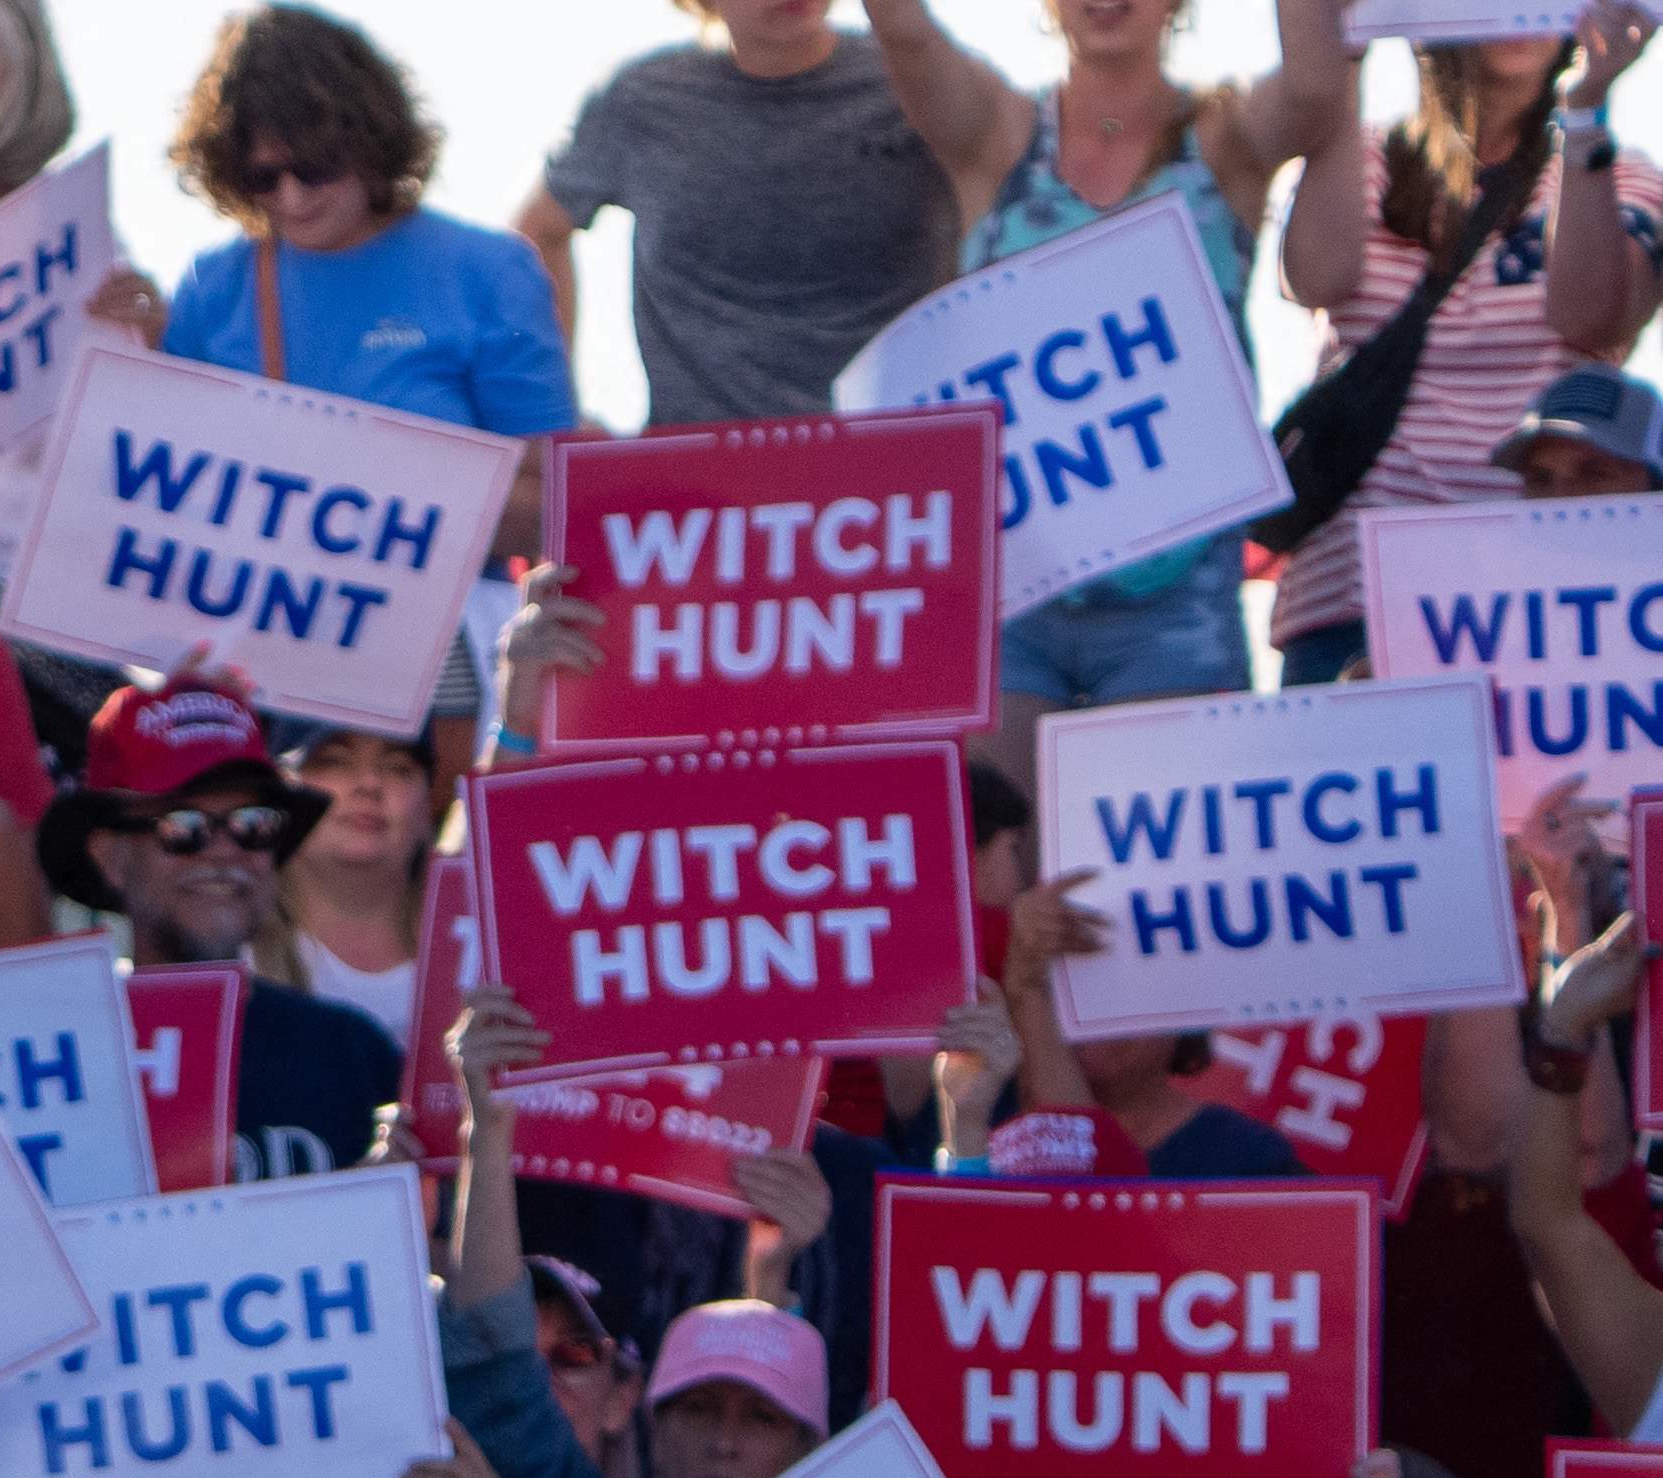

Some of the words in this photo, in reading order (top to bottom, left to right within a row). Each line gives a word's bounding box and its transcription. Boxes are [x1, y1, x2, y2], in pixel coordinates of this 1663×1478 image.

[913, 295, 1181, 430] TCH
[113, 428, 441, 570] WITCH
[1003, 398, 1170, 530] UNT
[105, 527, 388, 650] HUNT
[605, 490, 953, 588] WITCH
[633, 590, 925, 683] HUNT
[1420, 585, 1663, 664] WITC
[528, 814, 916, 915] WITCH
[1096, 763, 1440, 865] WITCH
[571, 907, 891, 1005] HUNT
[1131, 865, 1417, 955] HUNT
[60, 1262, 374, 1373] ITCH
[932, 1266, 1321, 1352] WITCH
[38, 1365, 348, 1476] HUNT
[964, 1371, 1289, 1452] HUNT
